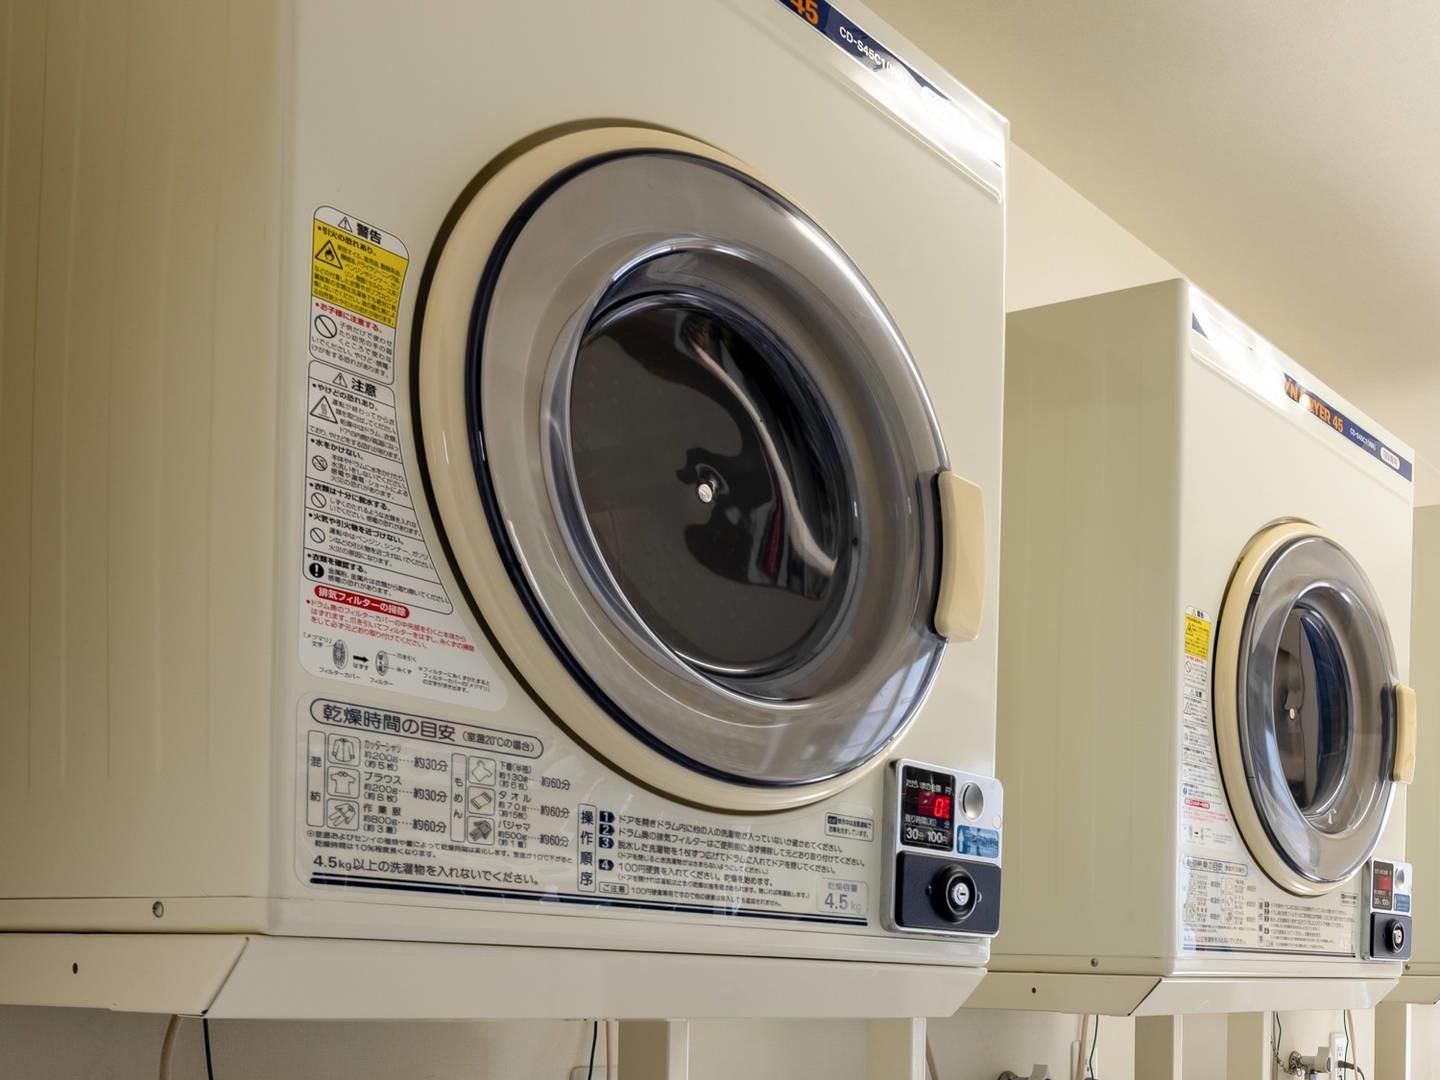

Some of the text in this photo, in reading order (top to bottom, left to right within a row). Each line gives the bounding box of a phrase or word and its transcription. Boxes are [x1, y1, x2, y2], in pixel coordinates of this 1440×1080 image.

[357, 222, 381, 245] 警告
[351, 377, 376, 397] 注意
[1332, 415, 1344, 433] 45
[318, 587, 406, 616] 排気フィルターの掃除
[323, 704, 456, 742] 乾燥時間の目安
[414, 756, 448, 772] 約30分
[541, 776, 571, 791] 約60分
[413, 787, 447, 803] 約30分
[540, 804, 570, 819] 約60分
[412, 818, 447, 834] 約60分
[539, 833, 569, 847] 約60分
[580, 809, 593, 886] 操作順序
[313, 854, 539, 886] 4.5kg以上の洗濯物を入れないでください。
[824, 893, 849, 910] 4.5
